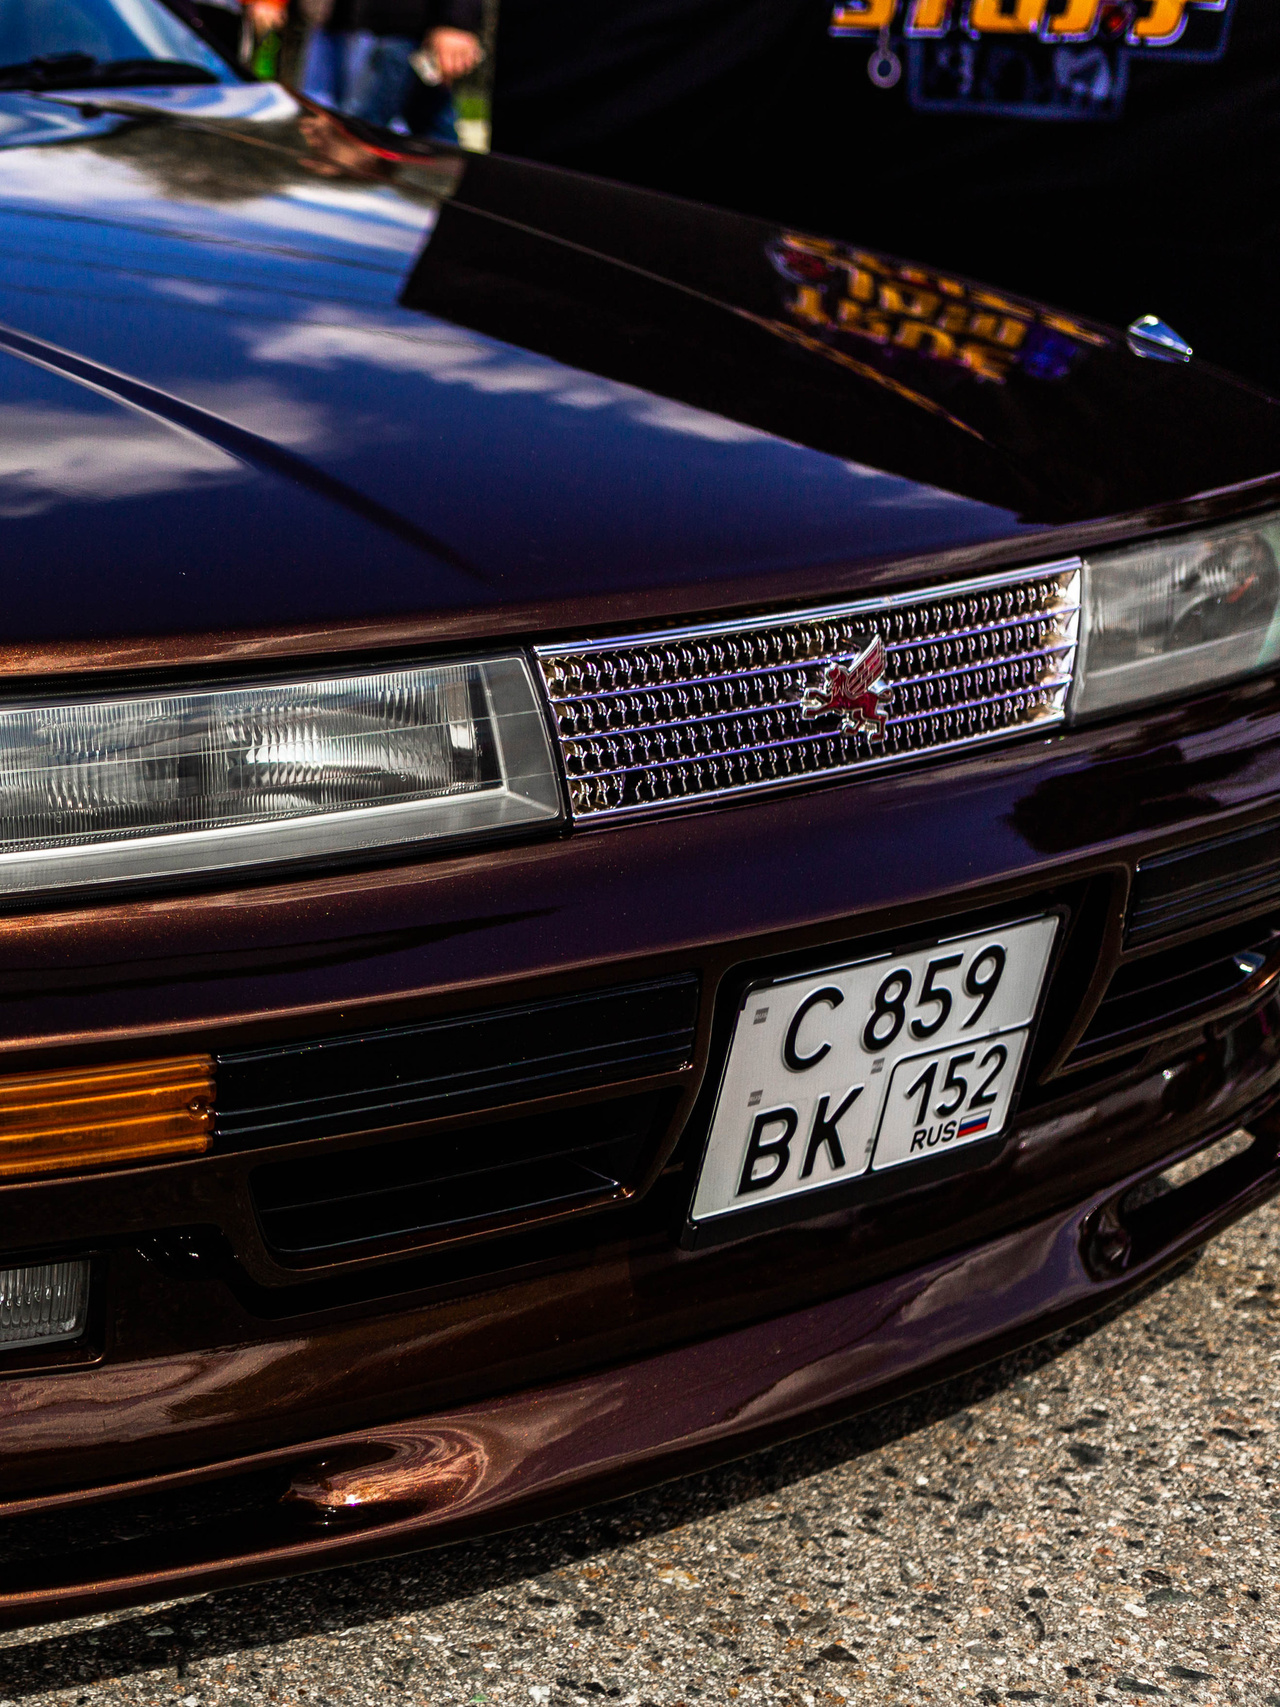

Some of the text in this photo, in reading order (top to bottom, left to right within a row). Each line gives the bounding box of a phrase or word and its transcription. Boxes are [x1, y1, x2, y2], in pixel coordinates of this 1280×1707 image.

[784, 944, 1007, 1071] C 859
[906, 1044, 1008, 1126] 152
[736, 1084, 865, 1197] BK
[910, 1119, 958, 1153] RUS
